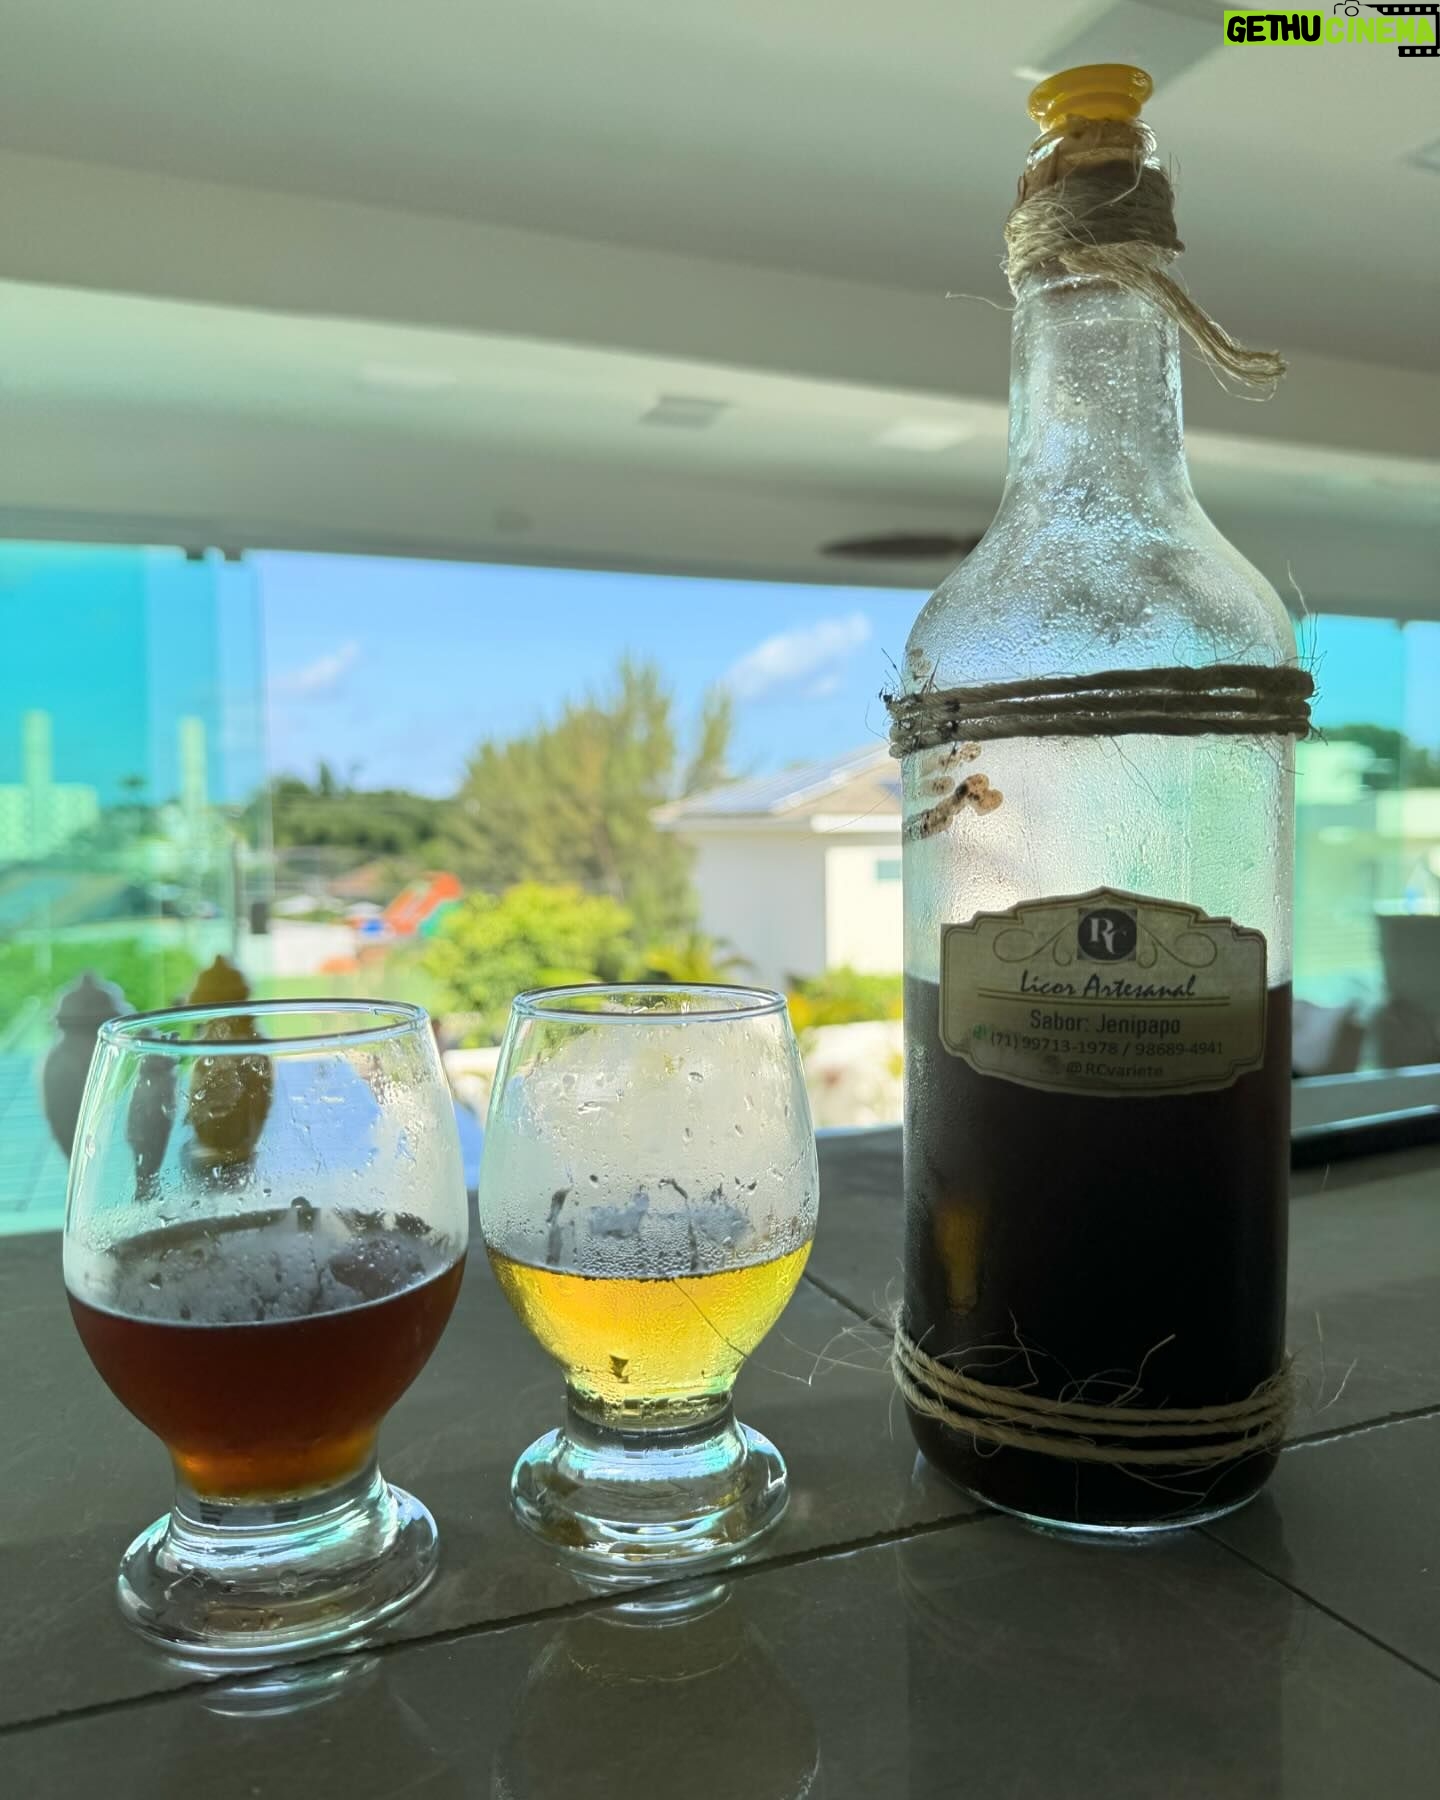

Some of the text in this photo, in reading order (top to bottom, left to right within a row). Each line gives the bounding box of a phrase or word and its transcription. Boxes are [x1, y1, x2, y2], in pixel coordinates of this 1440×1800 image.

[1020, 970, 1196, 997] Licor Artesanal
[1030, 1009, 1180, 1039] Sabor: Jenipapo
